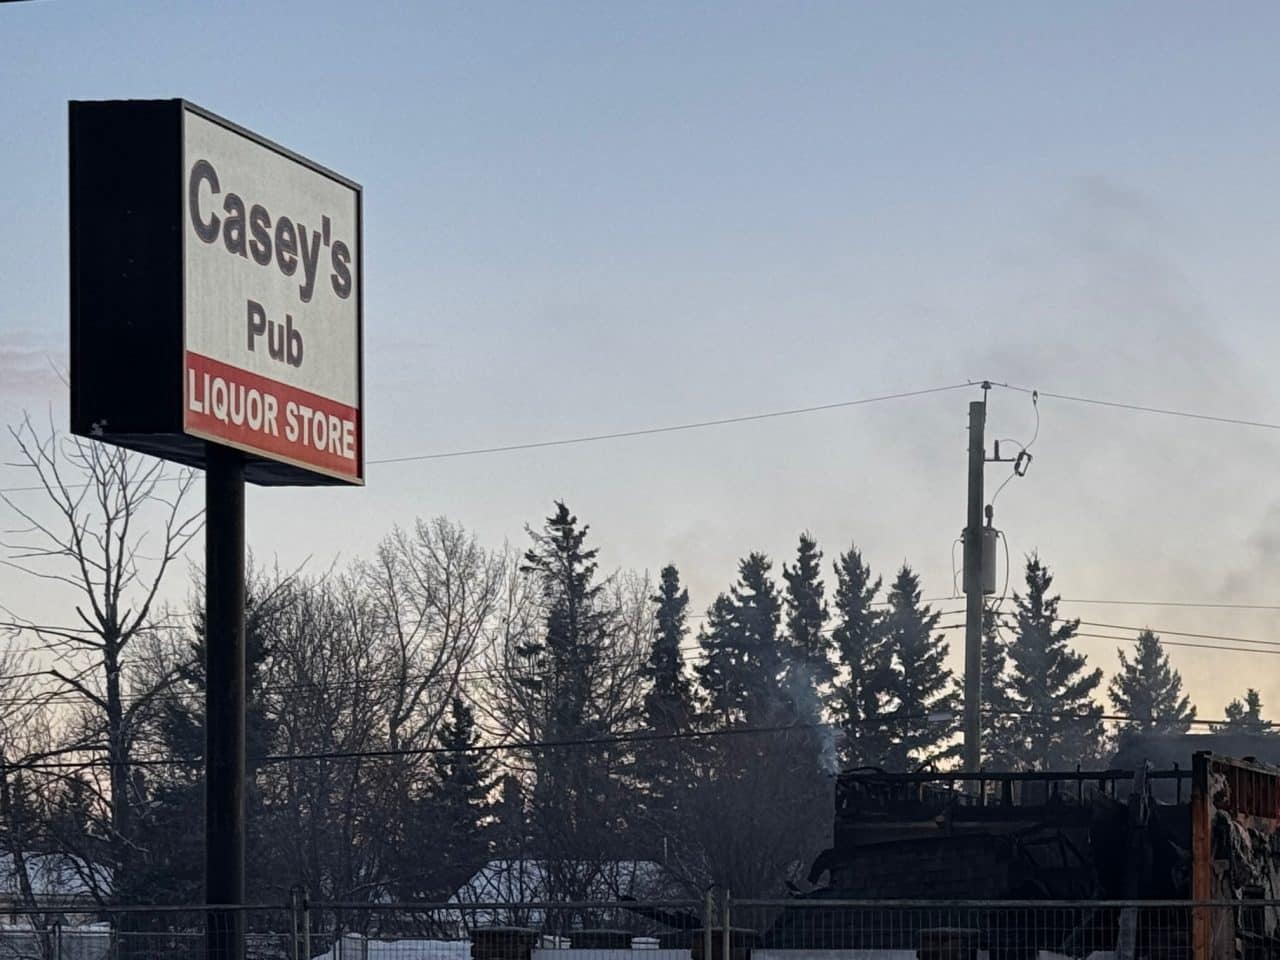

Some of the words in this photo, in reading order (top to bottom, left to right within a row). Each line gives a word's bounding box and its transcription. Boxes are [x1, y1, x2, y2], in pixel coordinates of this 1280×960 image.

[188, 159, 352, 303] Casey's
[247, 300, 304, 368] Pub
[188, 368, 278, 437] LIQUOR
[285, 401, 355, 459] STORE
